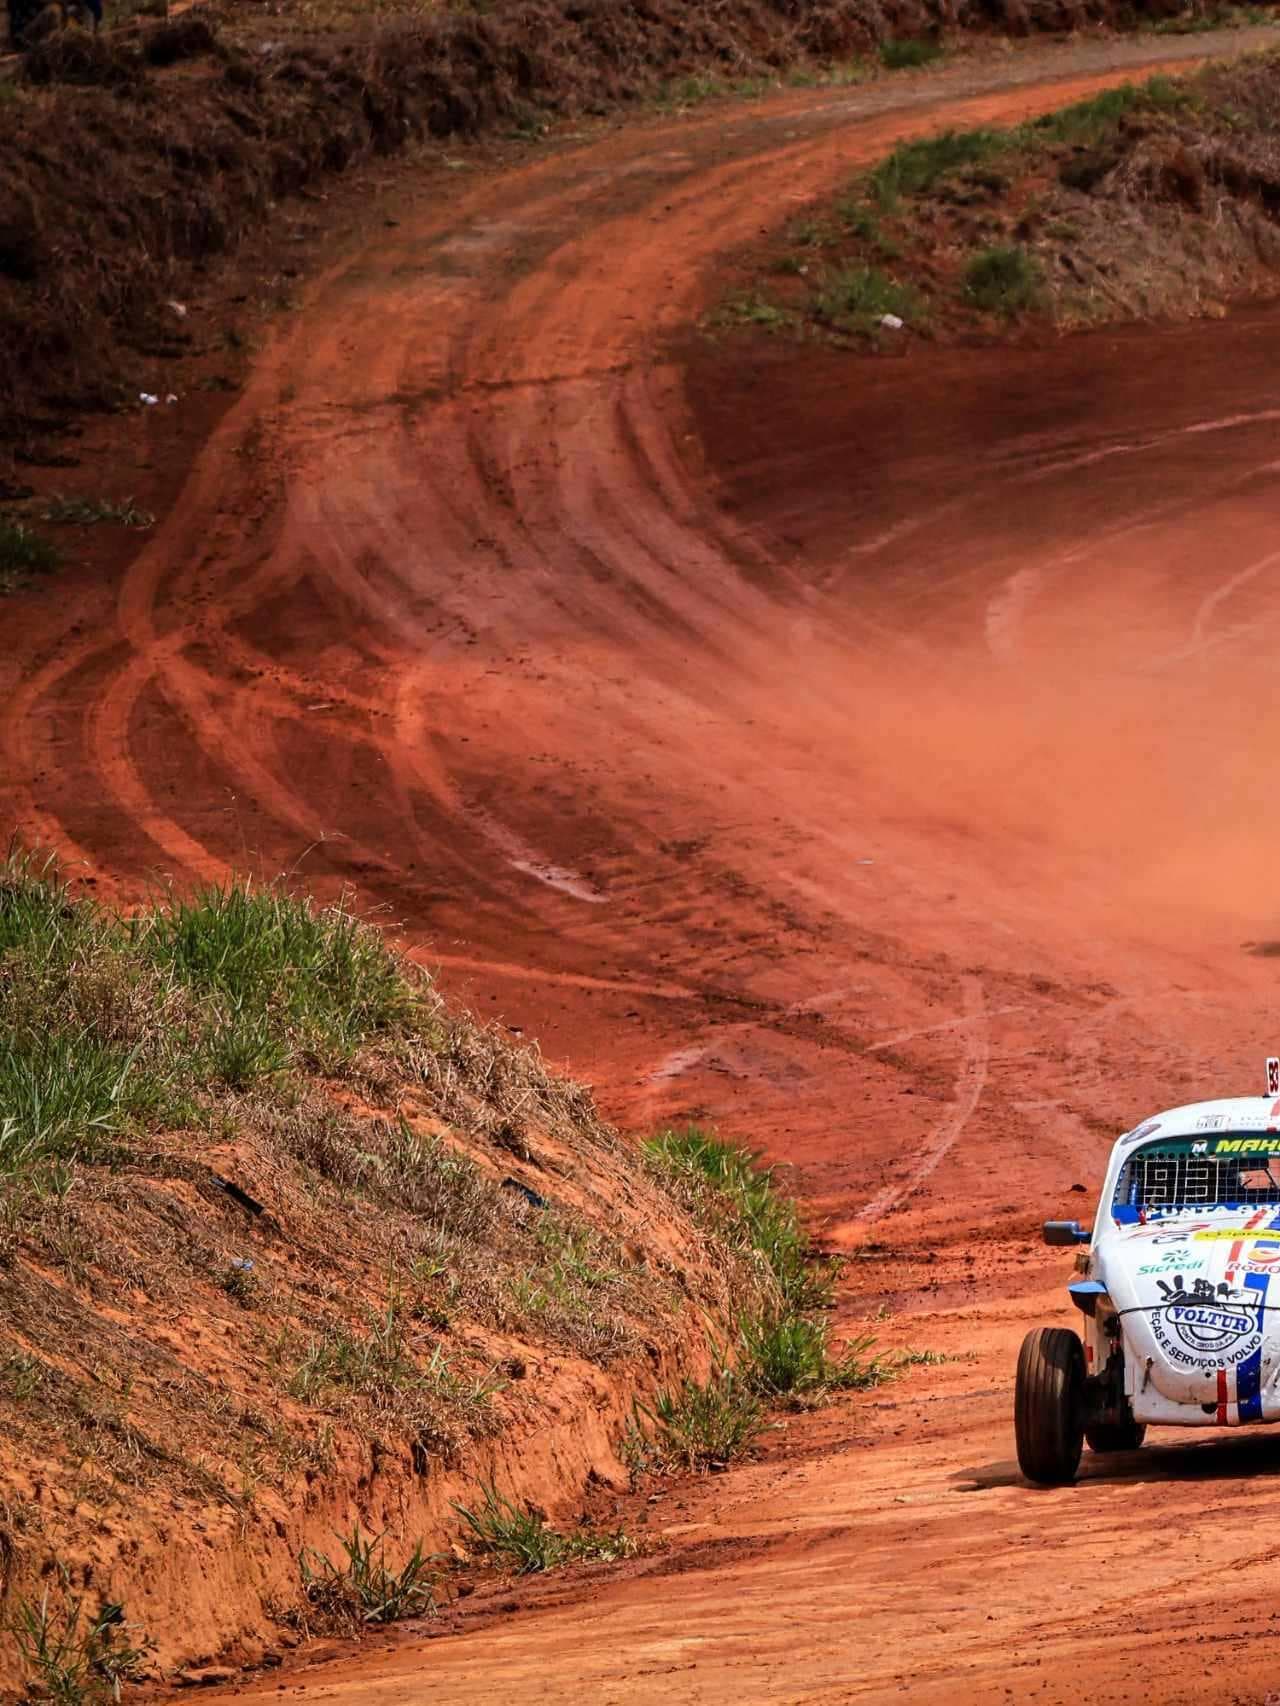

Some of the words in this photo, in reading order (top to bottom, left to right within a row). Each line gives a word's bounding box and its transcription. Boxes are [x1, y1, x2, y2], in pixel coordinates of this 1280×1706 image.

[1136, 1260, 1204, 1276] Sicredi
[1172, 1306, 1249, 1332] VOLTUR
[1161, 1338, 1172, 1350] E
[1169, 1346, 1225, 1370] SERVIÇOS
[1226, 1334, 1262, 1364] VOLVO
